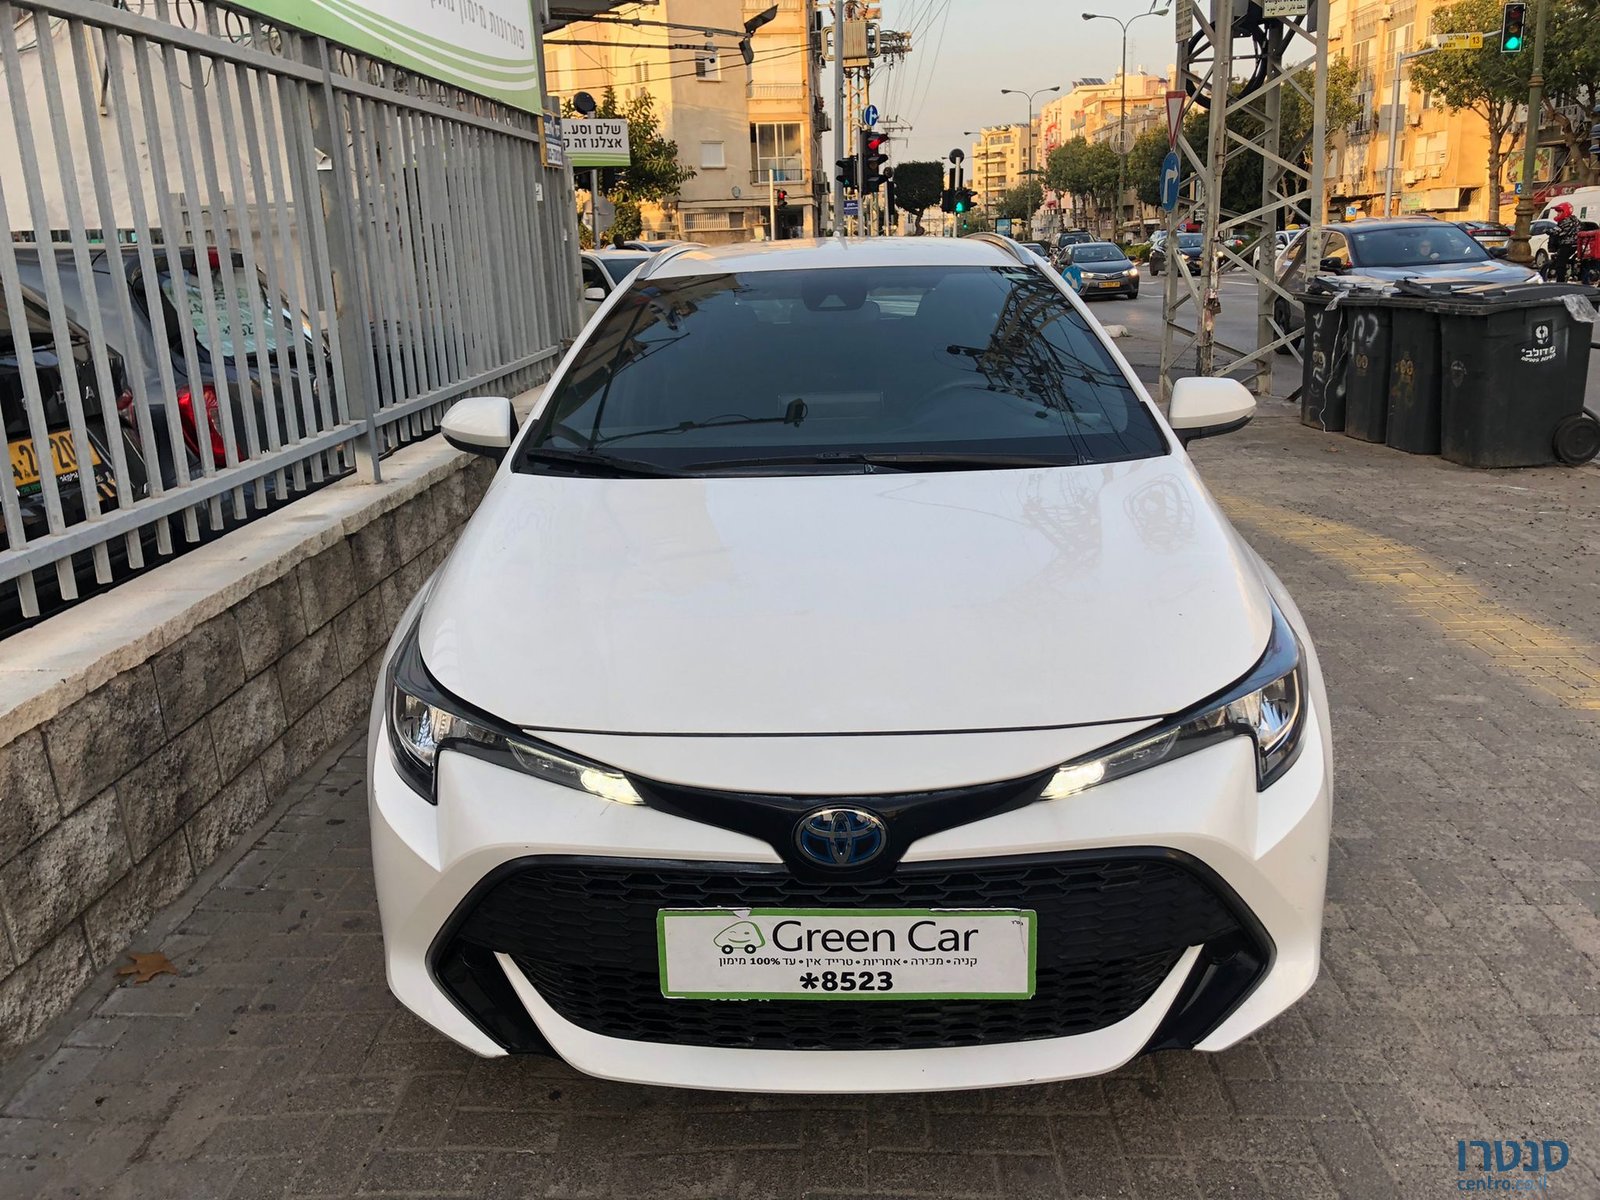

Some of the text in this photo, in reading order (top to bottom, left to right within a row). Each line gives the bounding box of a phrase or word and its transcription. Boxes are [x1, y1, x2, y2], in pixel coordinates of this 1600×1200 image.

[488, 11, 525, 50] פתרונות
[1472, 36, 1480, 44] 13
[596, 122, 621, 135] שלם
[574, 138, 587, 149] זה
[591, 136, 622, 149] אצלנו
[772, 920, 979, 953] Green Car
[719, 957, 978, 968] קניה מכירה אחריות טרייד אין עד 100% מימון
